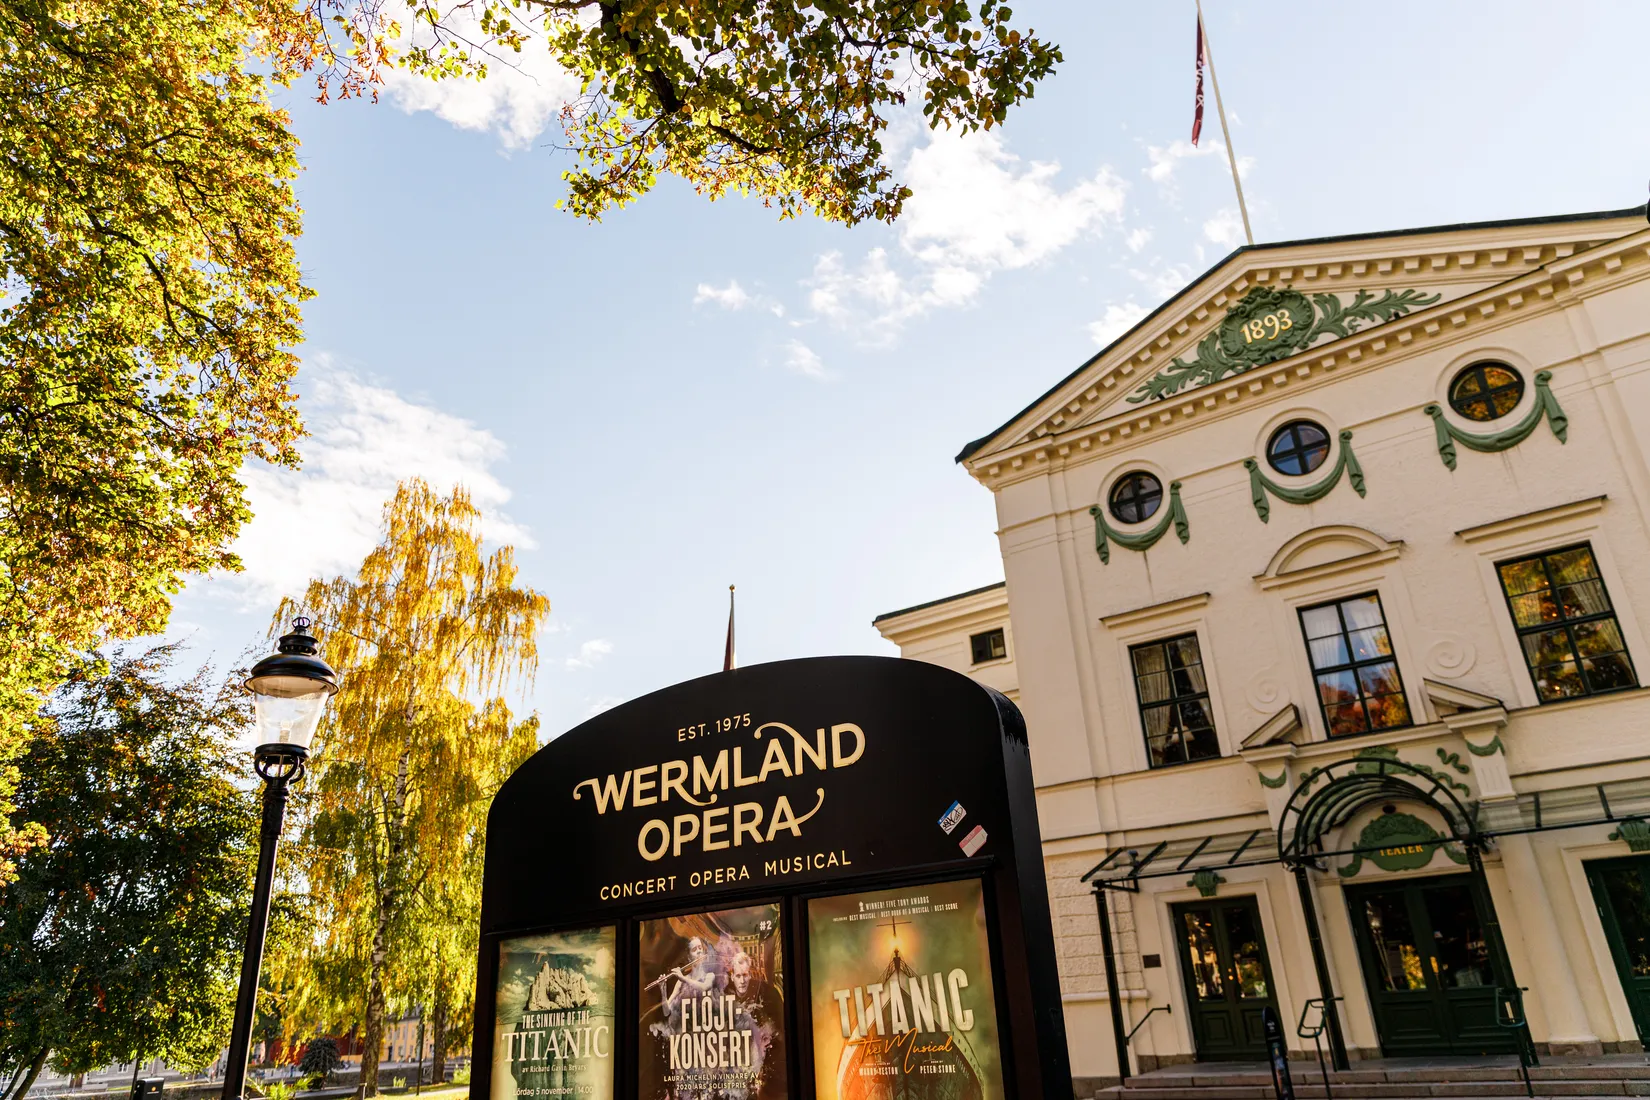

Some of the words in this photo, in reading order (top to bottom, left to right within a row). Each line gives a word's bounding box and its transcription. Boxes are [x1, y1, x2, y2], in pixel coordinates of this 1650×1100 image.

[1240, 309, 1292, 344] 1893
[677, 724, 710, 742] EST.
[716, 713, 751, 733] 1975
[573, 722, 866, 815] WERMLAND
[637, 787, 824, 862] OPERA
[600, 876, 677, 900] CONCERT
[690, 865, 750, 887] OPERA
[765, 850, 851, 877] MUSICAL
[759, 920, 772, 931] #2
[522, 1014, 535, 1029] THE
[537, 1012, 565, 1028] SINKING
[567, 1011, 576, 1025] OF
[578, 1010, 590, 1025] THE
[681, 990, 742, 1033] FLÖJT-
[833, 968, 975, 1038] TITANIC
[502, 1025, 609, 1062] TITANIC
[669, 1030, 752, 1070] KONSERT
[848, 1038, 882, 1063] The
[885, 1027, 953, 1074] Musical
[530, 1065, 550, 1073] Richard
[676, 1083, 691, 1091] 2020
[709, 1082, 746, 1090] SOLISTPRIS
[920, 1065, 937, 1074] PETER
[938, 1064, 956, 1073] STONE
[513, 1087, 534, 1097] Lördag
[536, 1087, 540, 1095] 5
[541, 1086, 573, 1095] november
